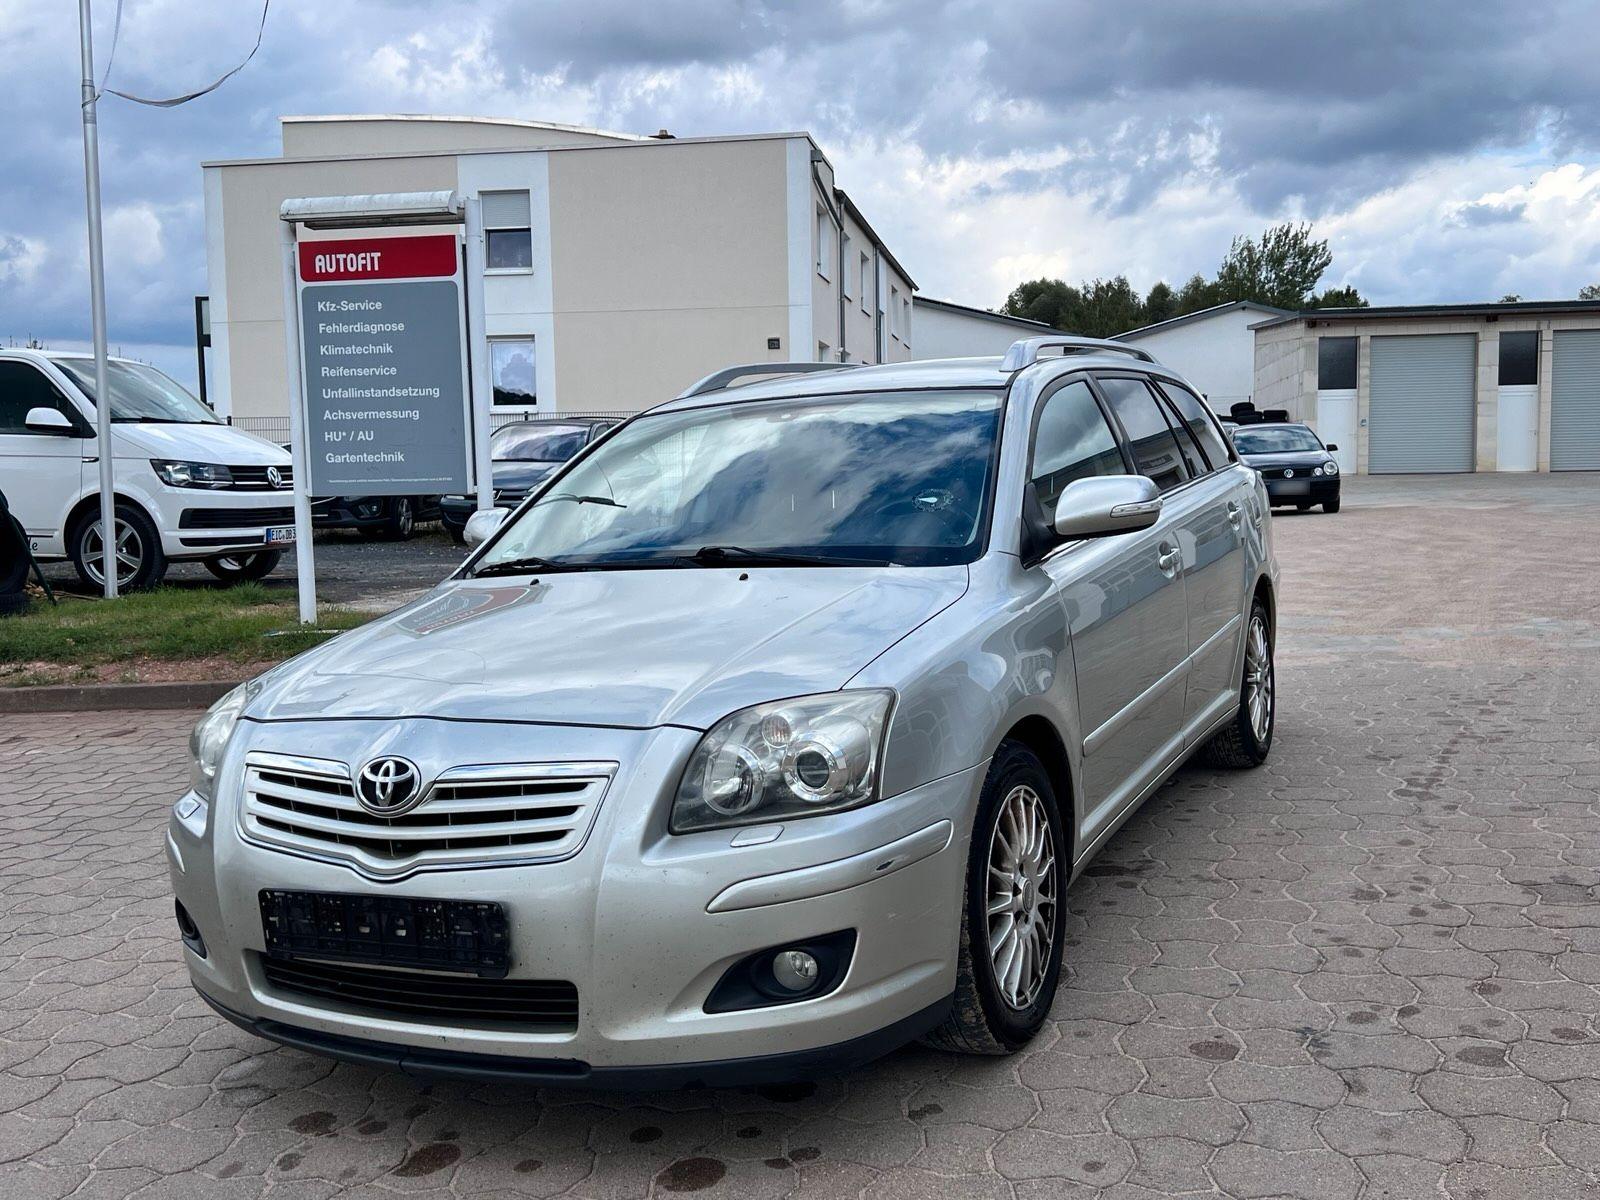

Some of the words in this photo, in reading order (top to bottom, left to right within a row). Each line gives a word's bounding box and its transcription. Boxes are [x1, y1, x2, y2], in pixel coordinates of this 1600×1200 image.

[315, 252, 381, 274] AUTOFIT
[317, 300, 383, 312] Kfz-Service
[318, 321, 405, 335] Fehlerdiagnose
[320, 343, 394, 355] Klimatechnik
[321, 365, 397, 377] Reifenservice
[322, 386, 440, 399] Unfallinstandsetzung
[323, 409, 420, 420] Achsvermessung
[357, 431, 374, 441] AU
[325, 452, 405, 463] Gartentechnik
